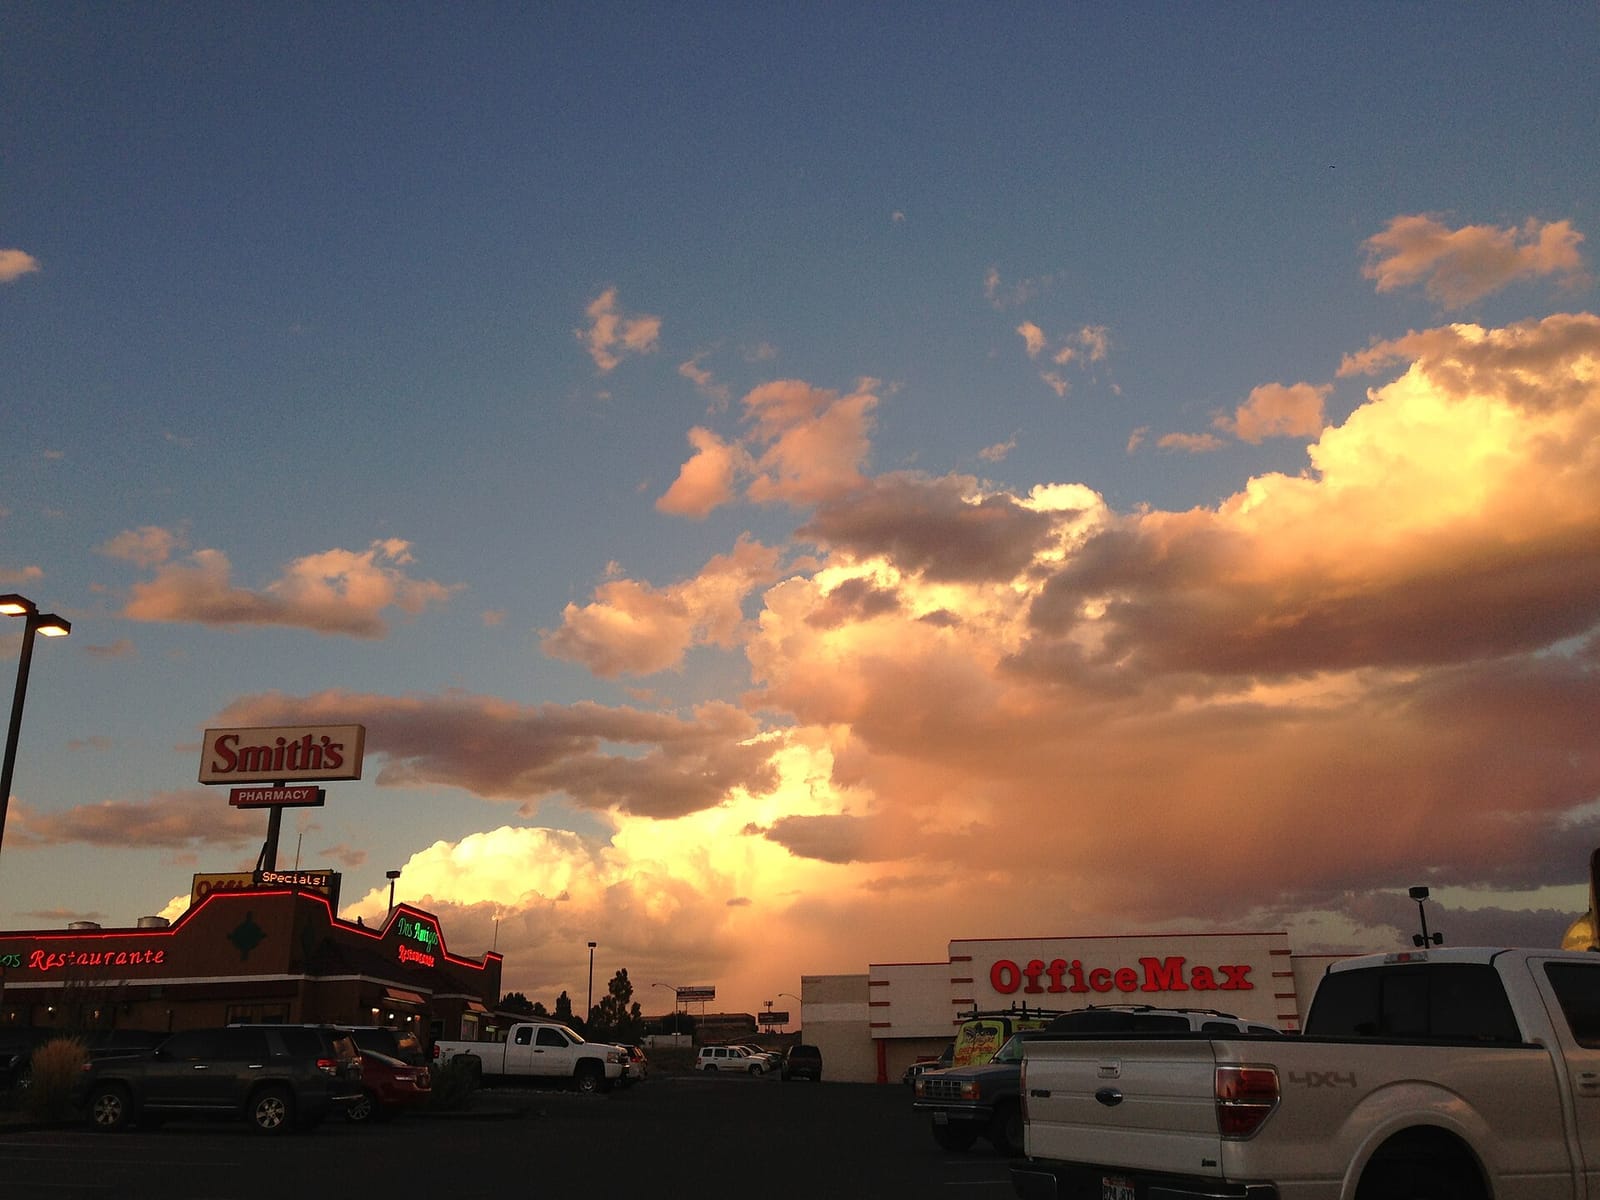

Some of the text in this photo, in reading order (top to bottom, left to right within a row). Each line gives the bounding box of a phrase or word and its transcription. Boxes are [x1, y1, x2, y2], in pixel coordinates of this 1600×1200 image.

[211, 734, 344, 773] Smith's
[238, 789, 309, 801] PHARMACY
[398, 917, 438, 953] Dos Amigos
[28, 949, 164, 972] Restaurante
[990, 956, 1254, 994] OfficeMax
